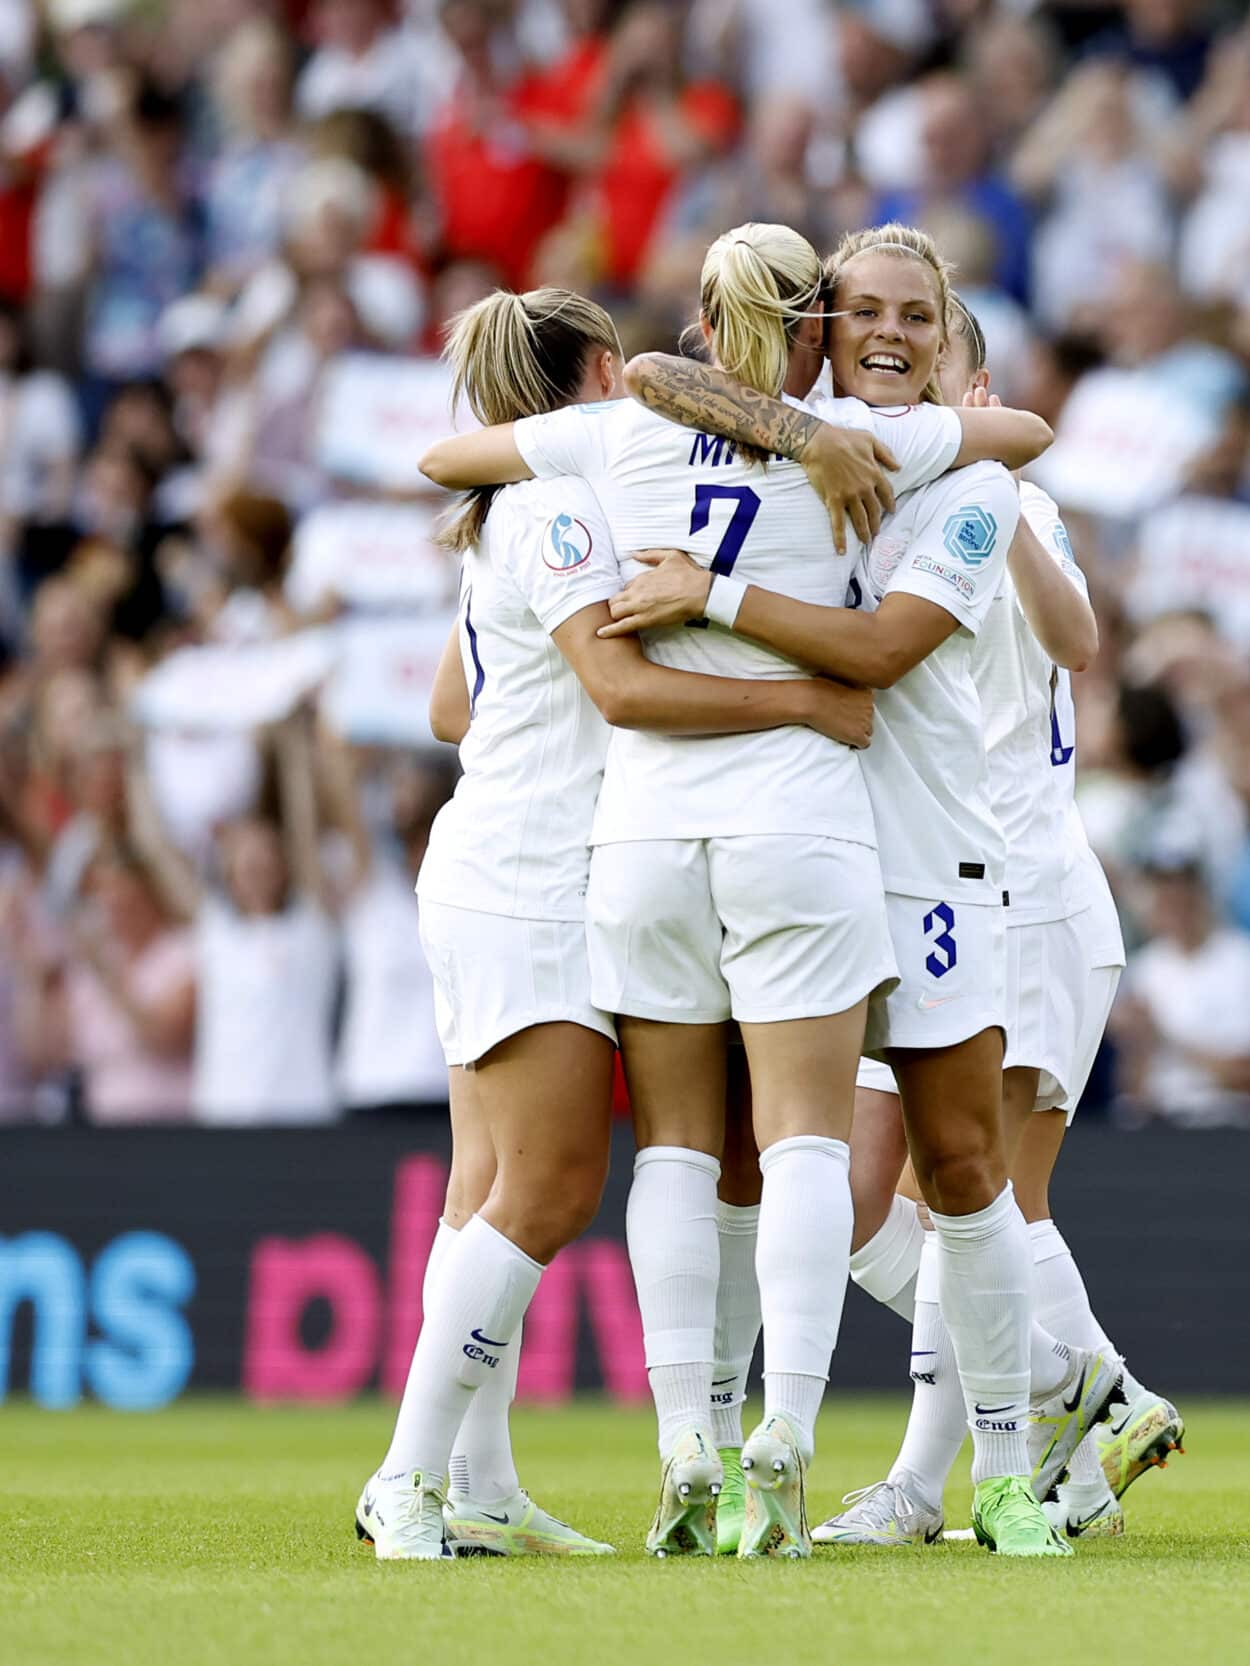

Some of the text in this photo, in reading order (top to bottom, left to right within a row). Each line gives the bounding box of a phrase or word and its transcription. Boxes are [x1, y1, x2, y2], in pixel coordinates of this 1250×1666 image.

[684, 484, 763, 628] 7
[912, 559, 976, 596] FOUNDATION
[923, 901, 957, 979] 3
[462, 1344, 500, 1369] Eng
[710, 1391, 733, 1405] ng
